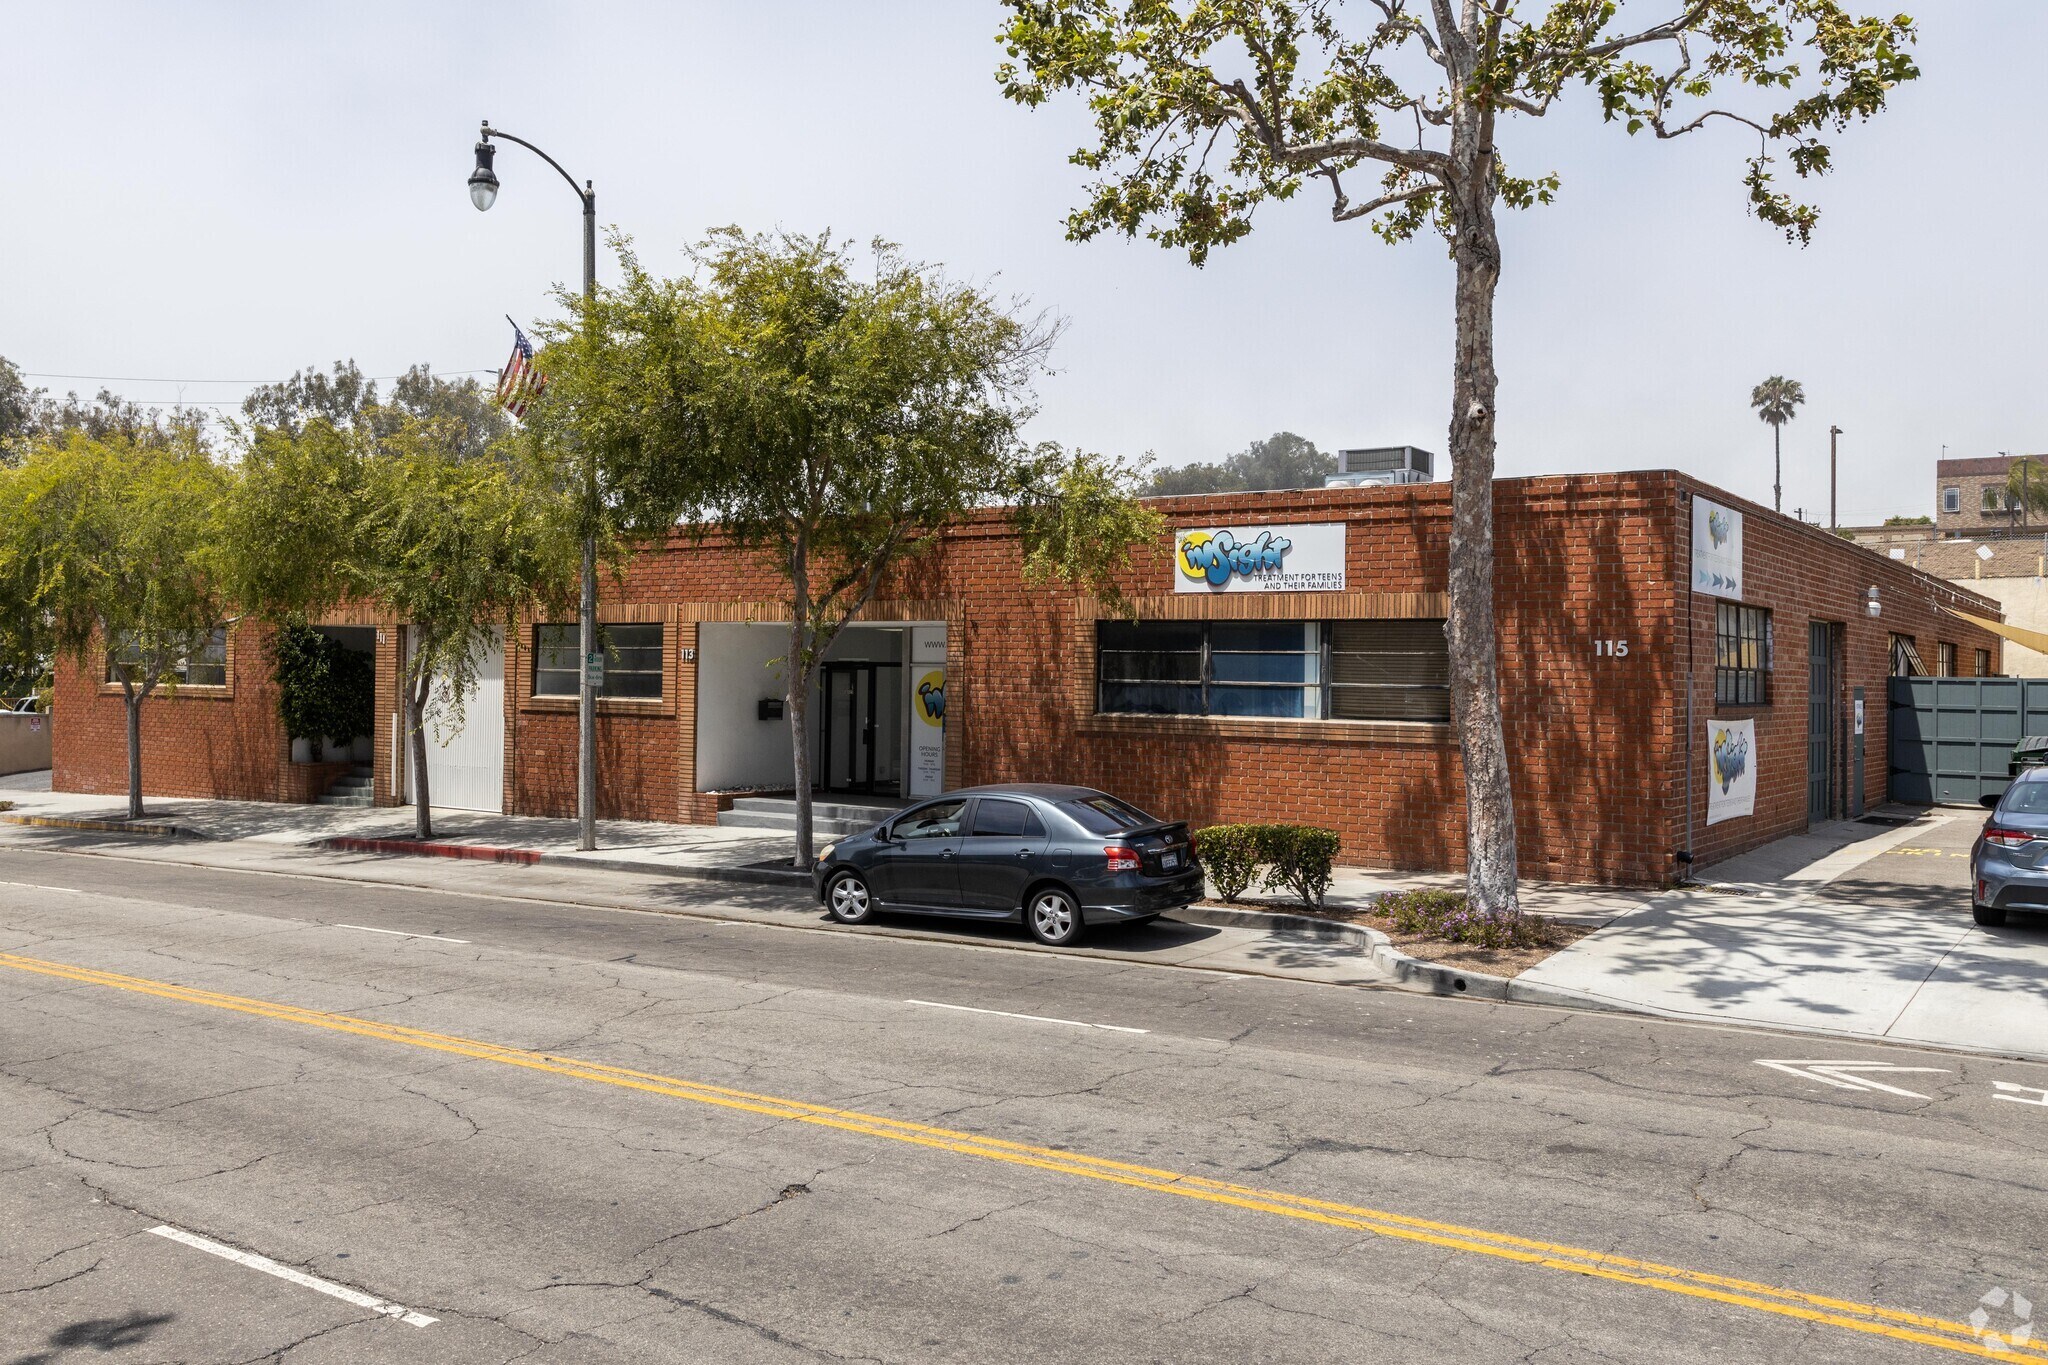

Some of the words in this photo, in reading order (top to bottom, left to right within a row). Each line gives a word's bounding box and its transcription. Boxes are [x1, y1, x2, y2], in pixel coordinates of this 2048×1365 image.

[1253, 573, 1299, 582] TREATMENT
[1301, 573, 1316, 582] FOR
[1318, 572, 1343, 581] TEENS
[1264, 582, 1281, 590] AND
[1284, 581, 1306, 590] THEIR
[1308, 581, 1343, 589] FAMILIES
[681, 648, 694, 660] 113
[1594, 640, 1629, 657] 115
